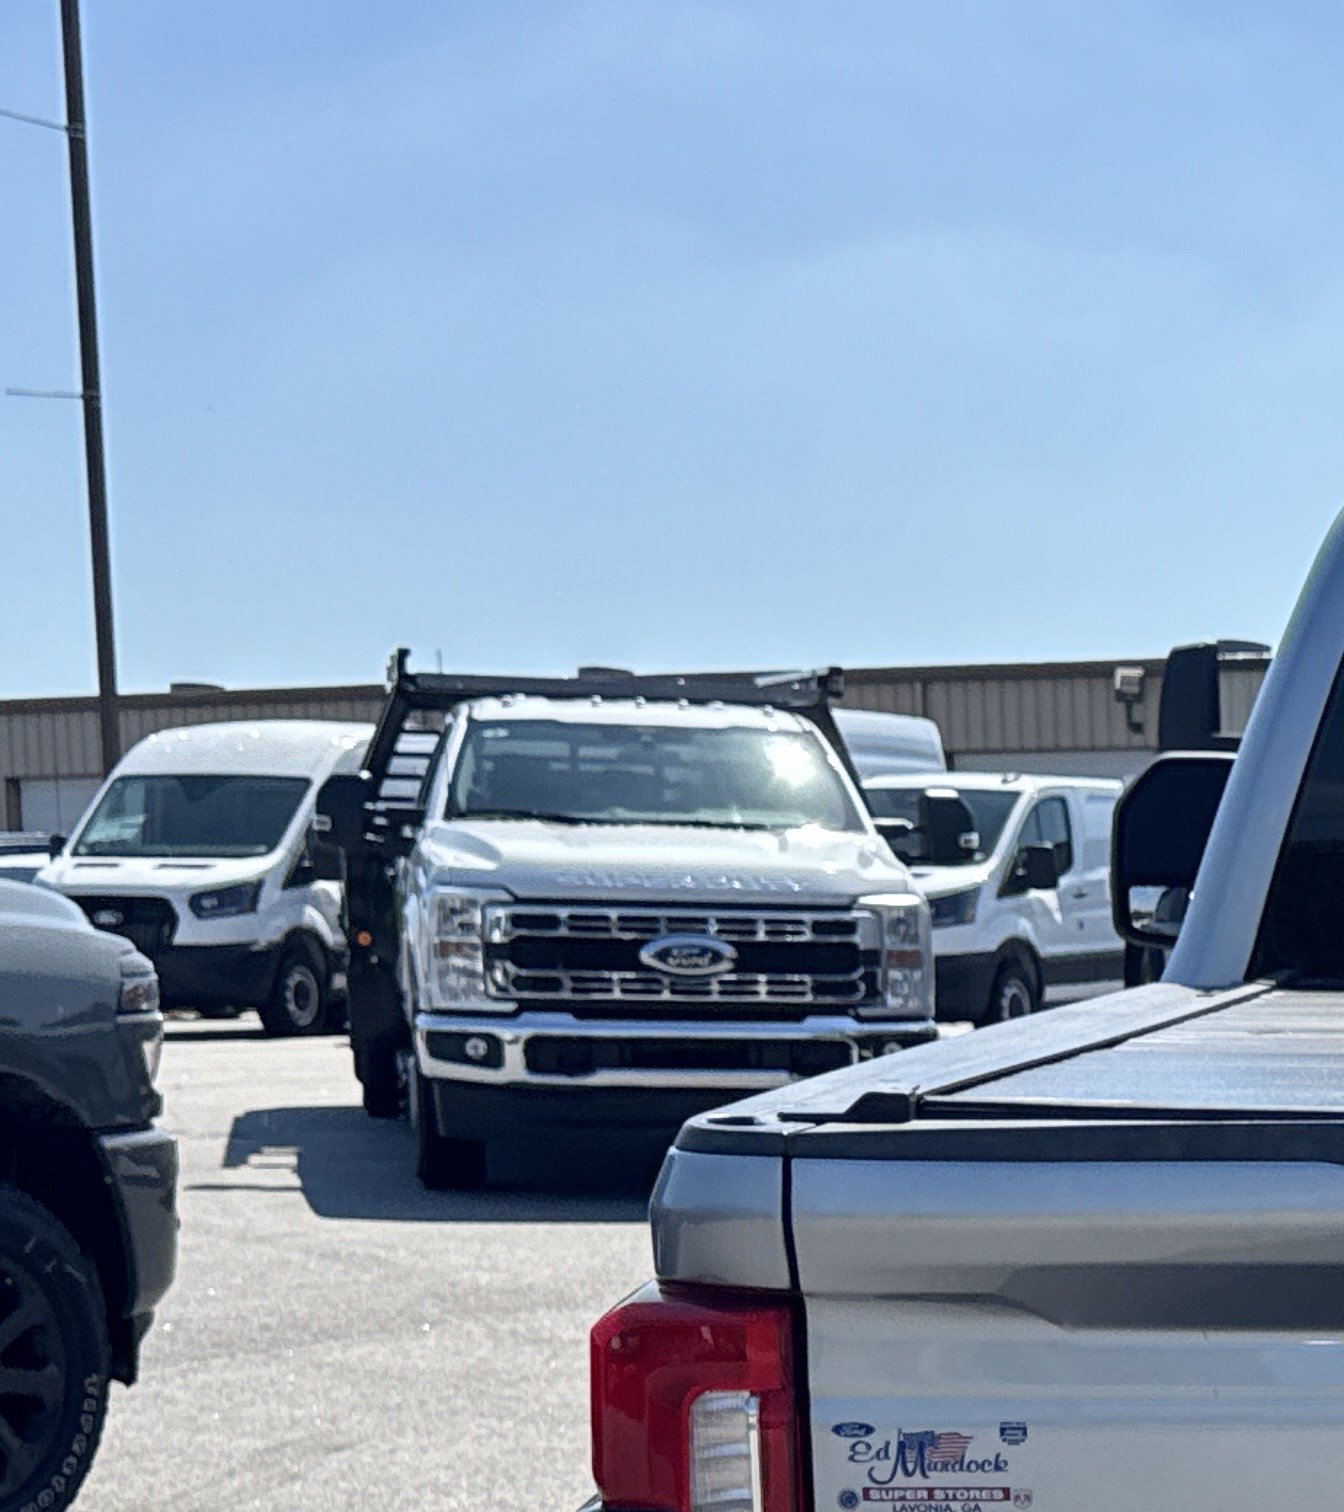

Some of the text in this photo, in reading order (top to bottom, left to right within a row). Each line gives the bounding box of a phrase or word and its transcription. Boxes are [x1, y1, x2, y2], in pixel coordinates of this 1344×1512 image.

[848, 1438, 1009, 1485] Ed Murdock
[868, 1488, 1005, 1500] SUPER STORES
